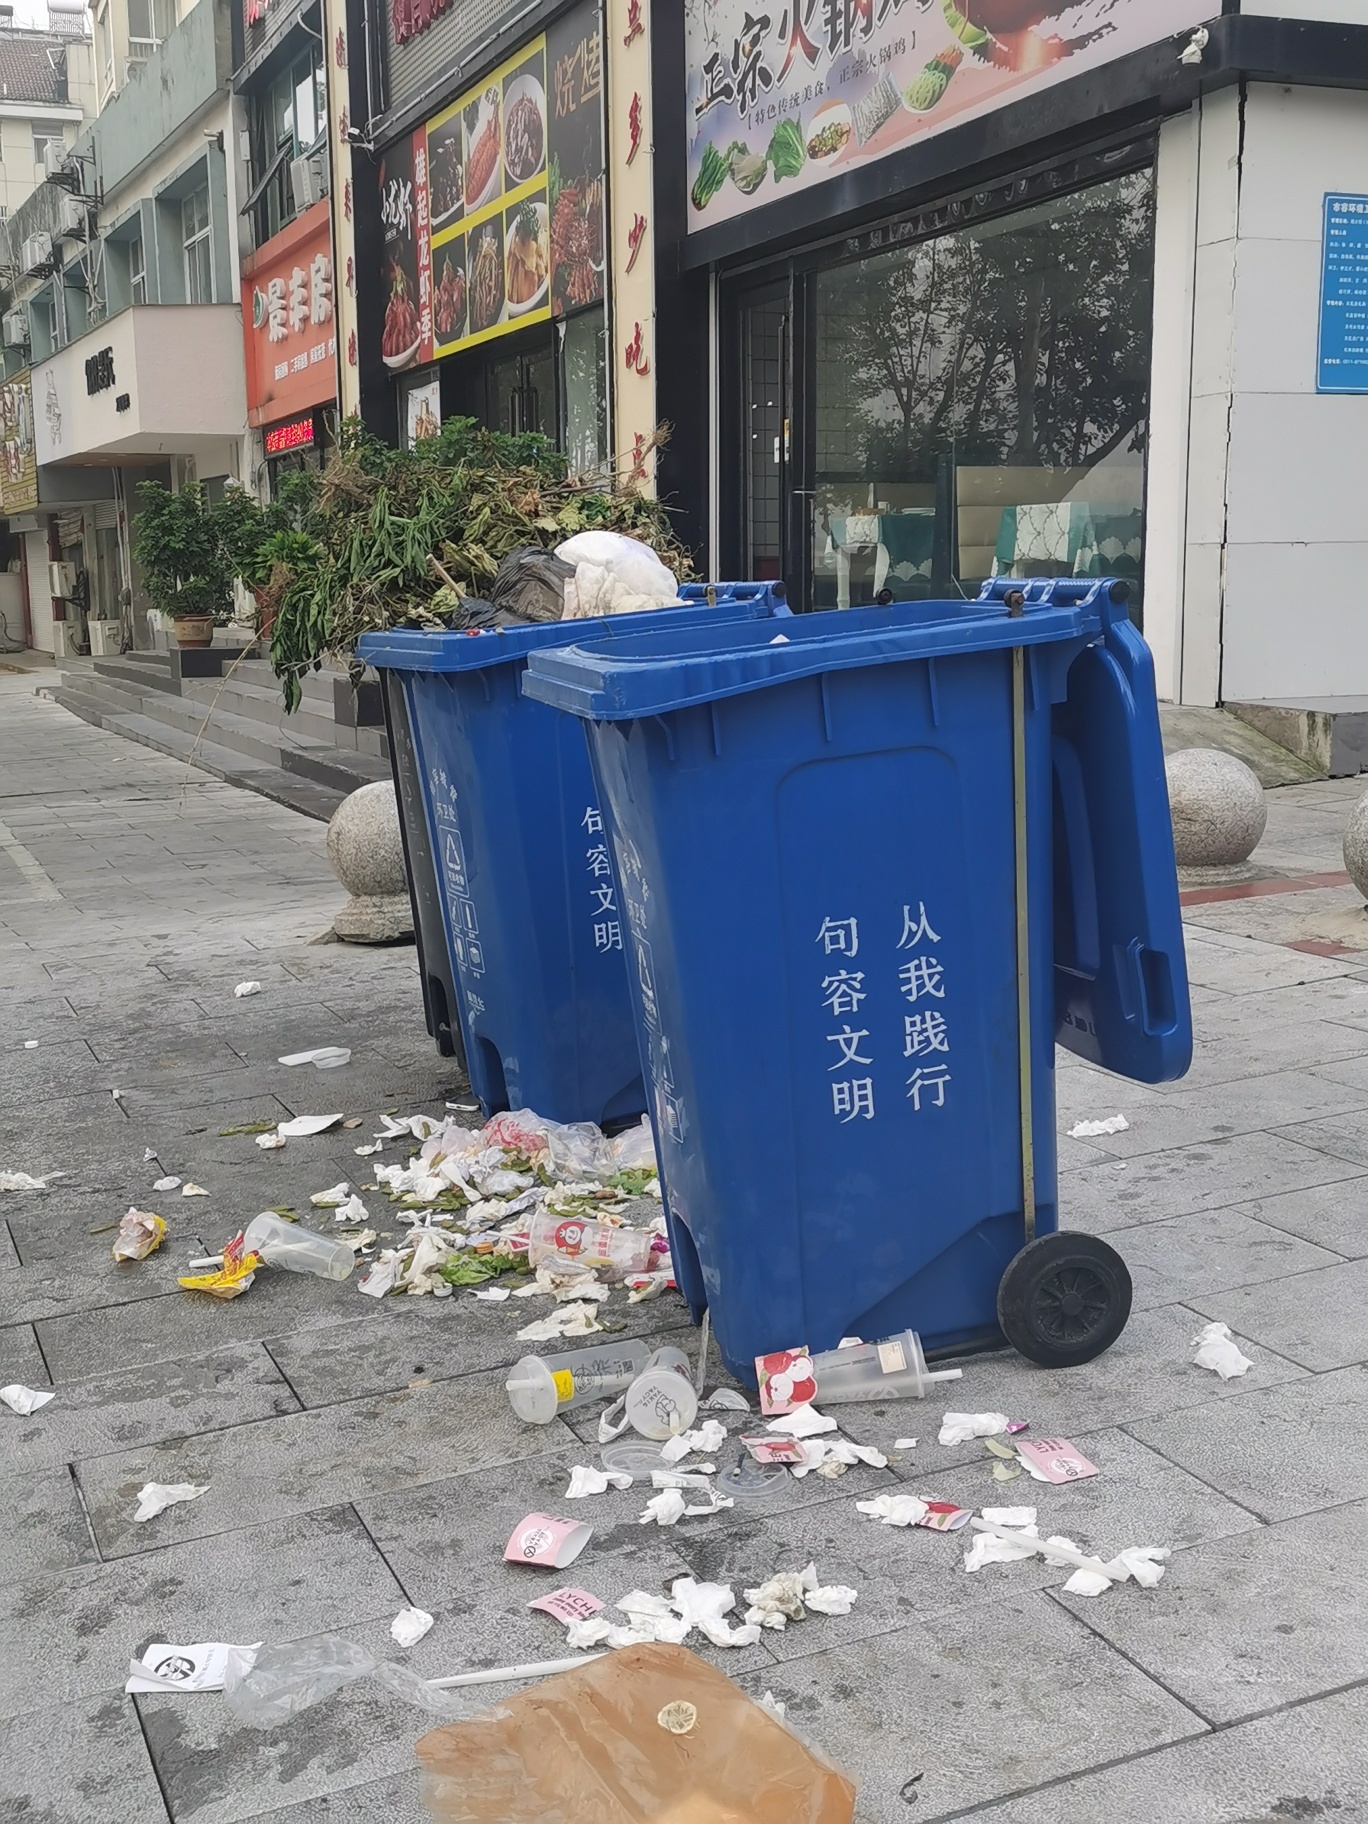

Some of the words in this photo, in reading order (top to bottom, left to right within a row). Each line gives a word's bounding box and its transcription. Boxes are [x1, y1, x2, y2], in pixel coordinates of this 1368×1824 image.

[695, 0, 927, 117] 正宗火锅
[580, 805, 624, 955] 句容文明
[815, 916, 875, 1124] 句容文明
[896, 901, 952, 1111] 从我践行
